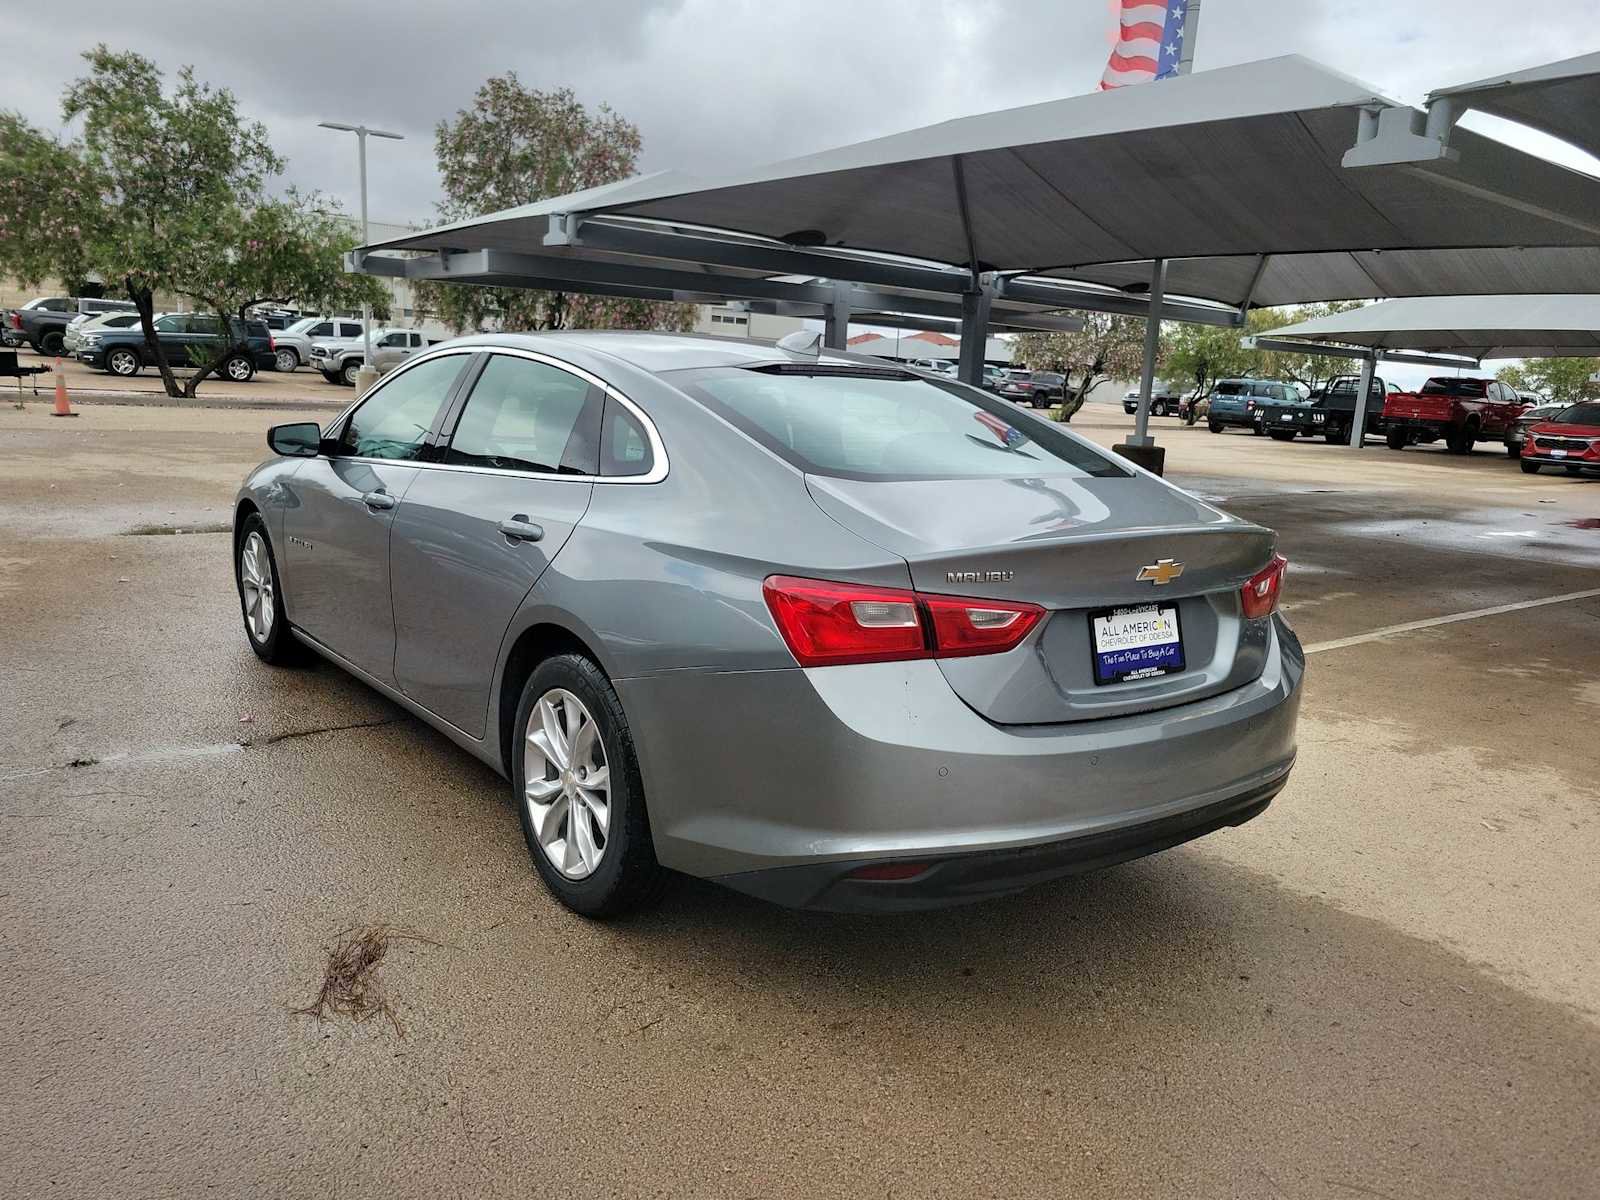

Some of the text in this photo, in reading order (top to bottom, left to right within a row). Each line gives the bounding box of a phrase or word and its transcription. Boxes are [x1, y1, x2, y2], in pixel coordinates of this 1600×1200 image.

[946, 571, 1014, 584] MALIBU
[1102, 625, 1120, 637] ALL
[1101, 631, 1173, 648] CHEVROLET OF ODESSA
[1103, 655, 1114, 665] The
[1124, 651, 1140, 662] Place
[1140, 649, 1148, 660] To
[1148, 648, 1160, 660] Buy
[1159, 647, 1166, 656] A
[1165, 646, 1175, 656] Car
